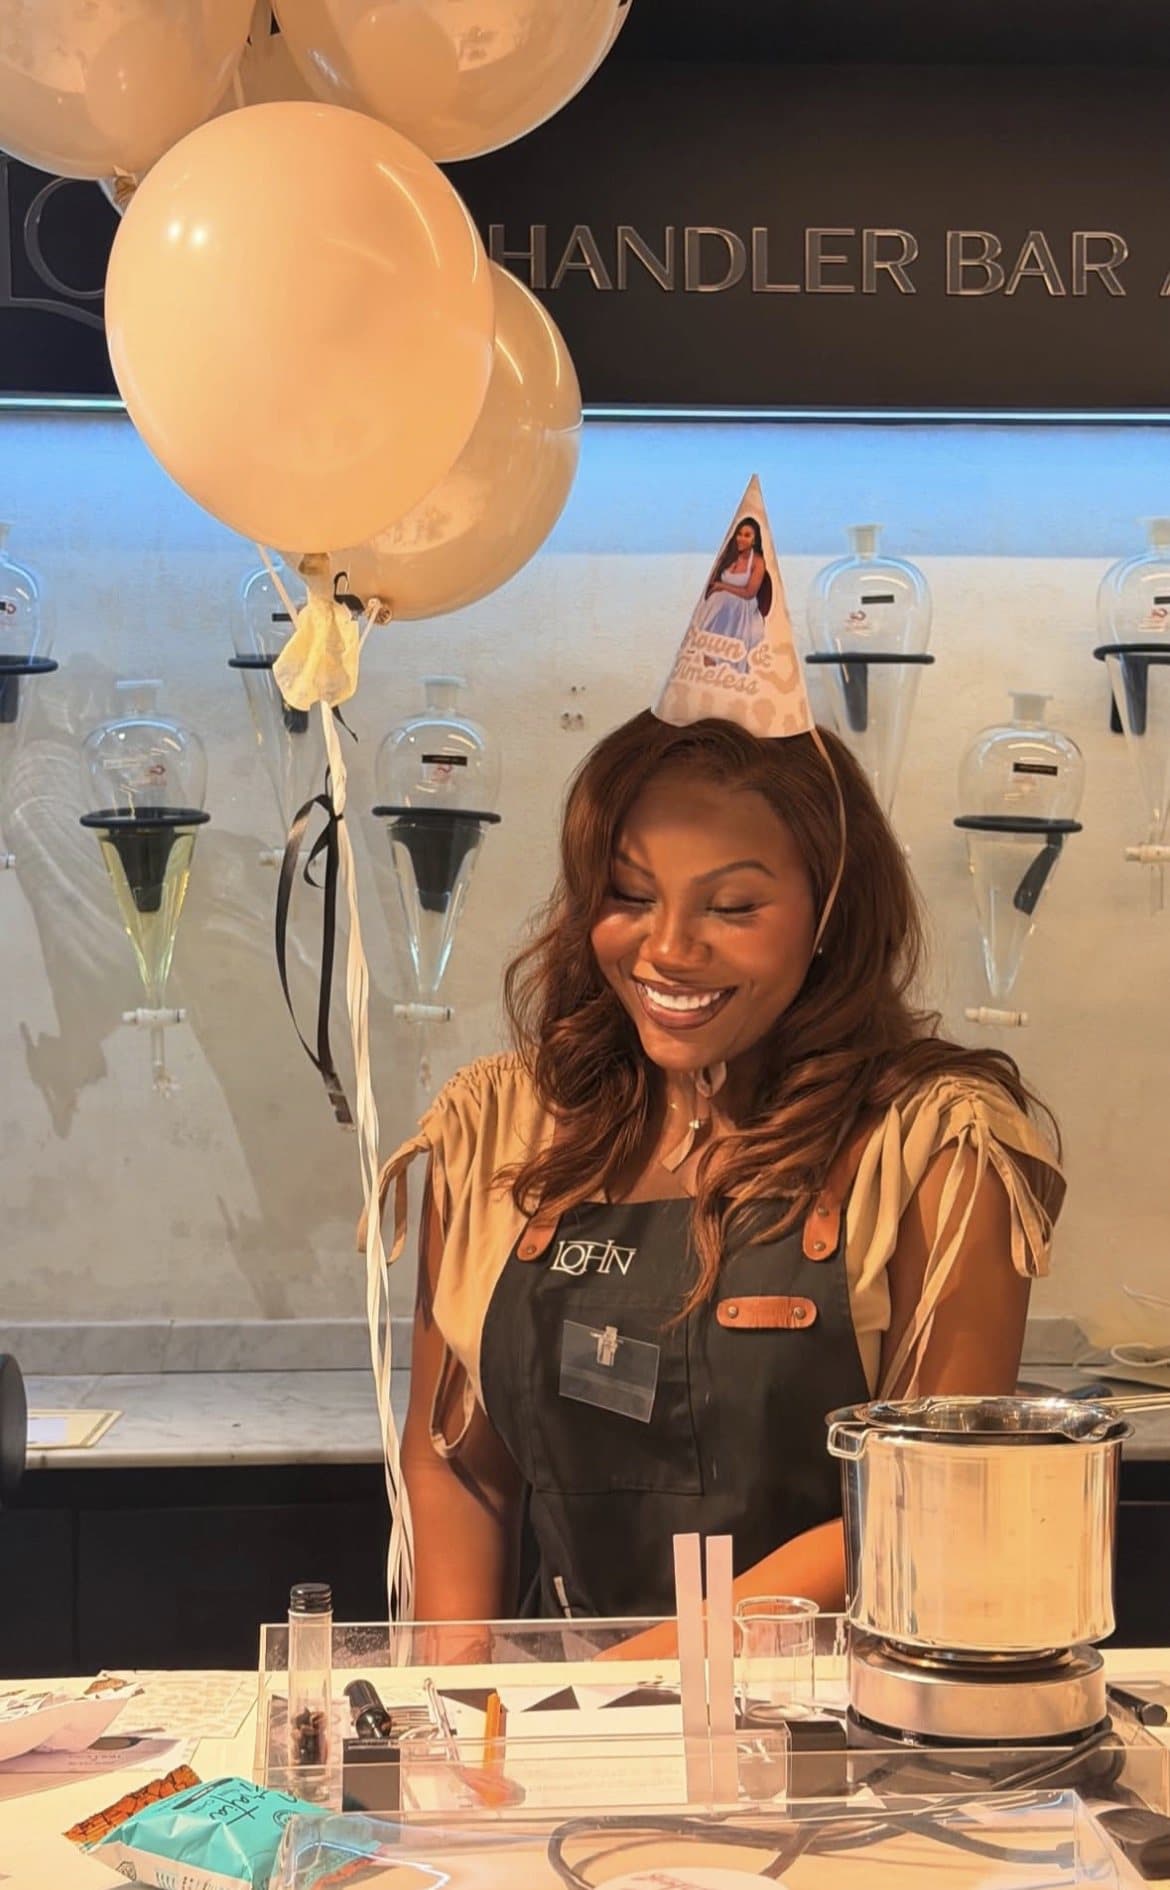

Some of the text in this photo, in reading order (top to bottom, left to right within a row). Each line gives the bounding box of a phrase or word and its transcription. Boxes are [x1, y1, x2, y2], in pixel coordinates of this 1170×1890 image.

[488, 224, 919, 295] HANDLER
[945, 230, 1129, 296] BAR
[751, 643, 773, 669] &
